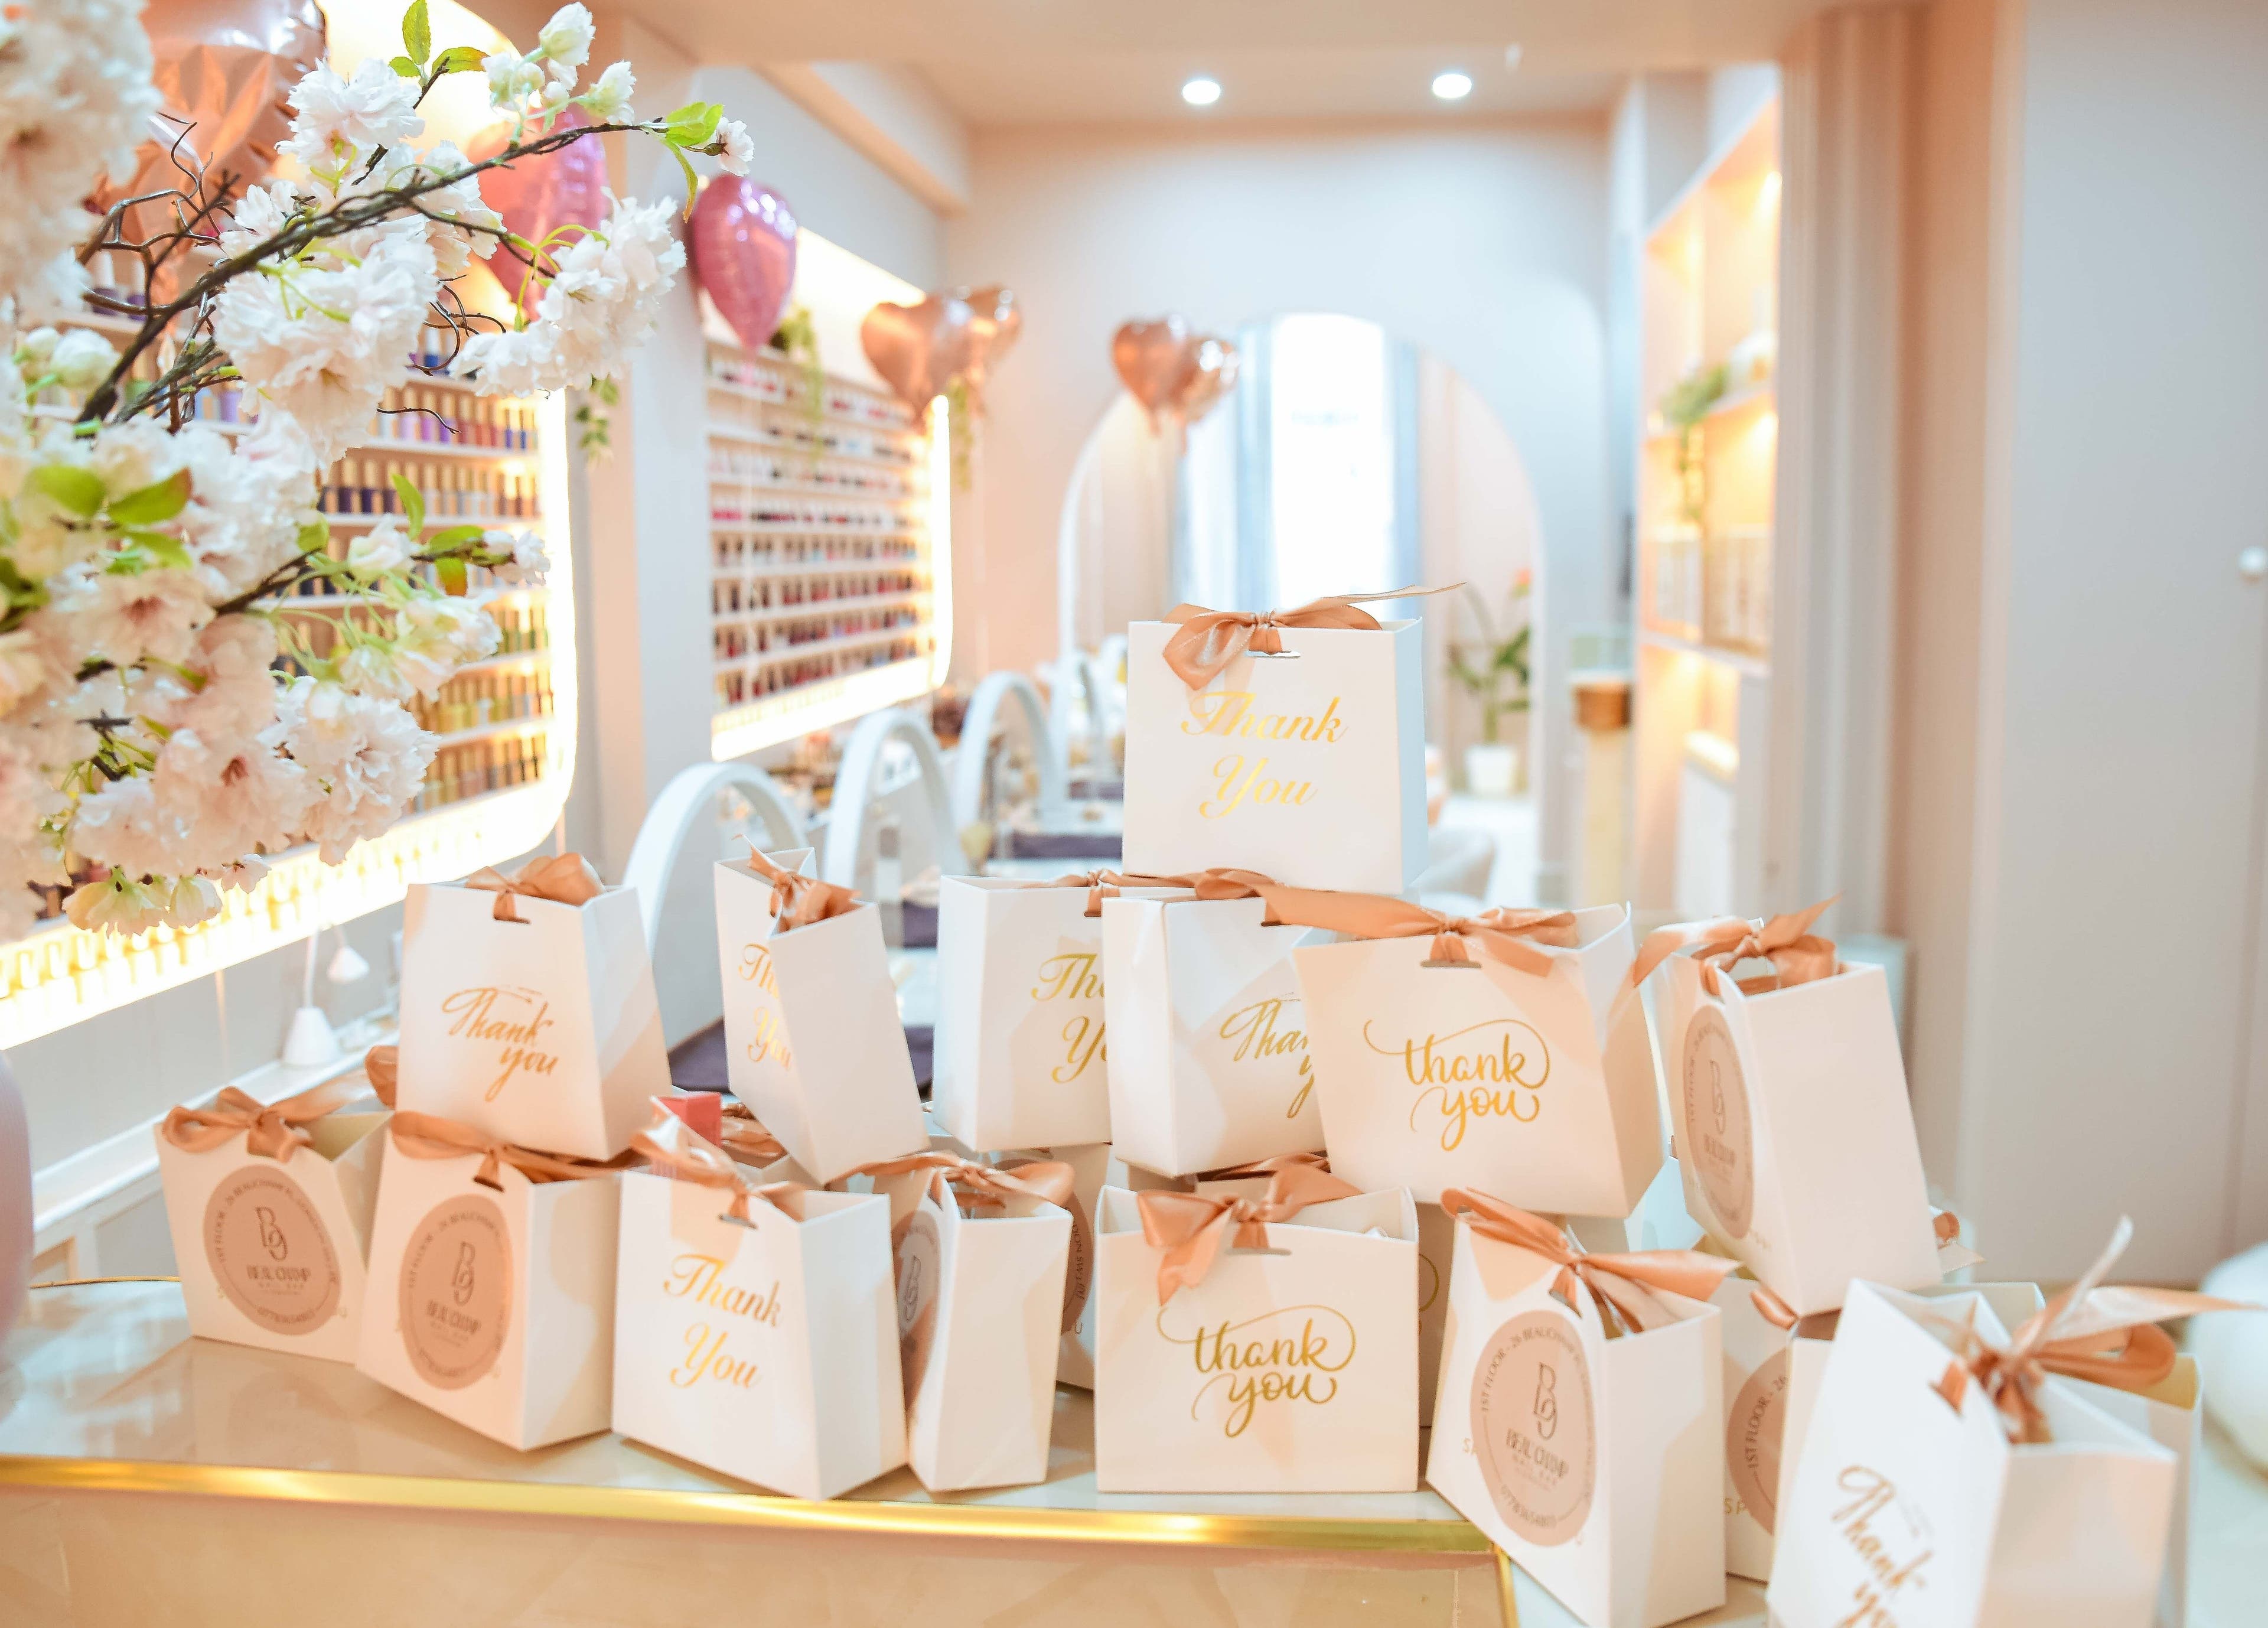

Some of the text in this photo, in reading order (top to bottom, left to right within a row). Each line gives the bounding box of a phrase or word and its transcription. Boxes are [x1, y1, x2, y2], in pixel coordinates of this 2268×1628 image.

[1181, 691, 1348, 743] Thank
[1199, 754, 1318, 819] You
[442, 985, 554, 1045] Thank
[485, 1047, 558, 1102] you
[1363, 1018, 1550, 1089] thank
[1410, 1086, 1540, 1151] you
[663, 1253, 783, 1327] Thank
[670, 1322, 762, 1389] You
[1156, 1305, 1355, 1373] thank
[1191, 1372, 1337, 1437] you
[1831, 1464, 1934, 1588] Thank
